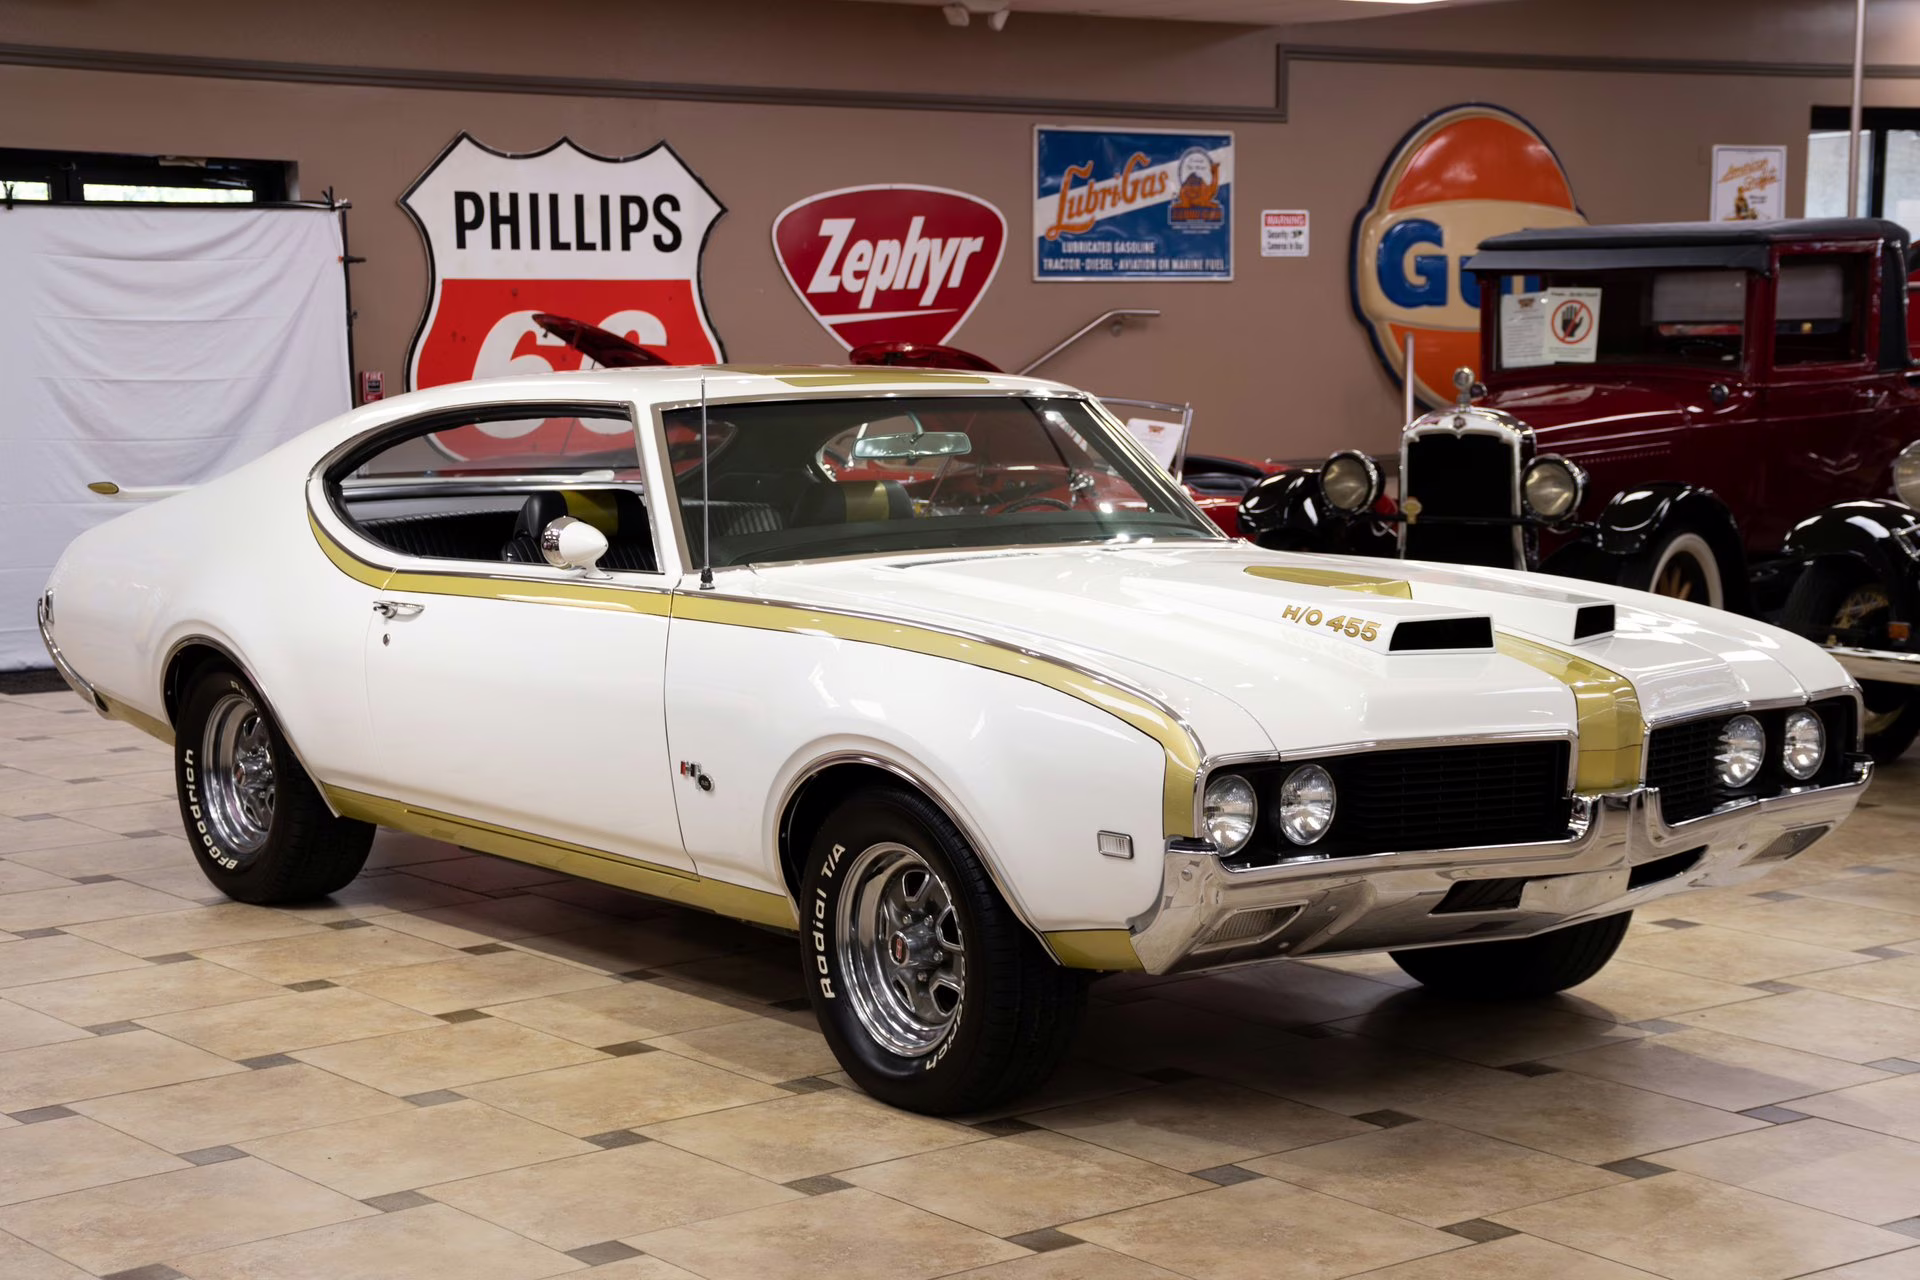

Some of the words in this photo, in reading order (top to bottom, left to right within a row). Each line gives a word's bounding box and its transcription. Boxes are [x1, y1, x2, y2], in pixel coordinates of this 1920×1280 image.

[454, 191, 683, 253] PHILLIPS
[1266, 215, 1305, 225] WARNING
[807, 216, 984, 309] Zephyr
[1043, 258, 1081, 271] TRACTOR
[1085, 258, 1113, 271] DIESEL
[1118, 258, 1157, 271] AVIATION
[1158, 258, 1170, 271] OR
[1171, 258, 1204, 271] MARINE
[1205, 258, 1226, 271] FUEL
[1062, 241, 1112, 254] LUBRICATED
[1114, 242, 1156, 254] GASOLINE
[1282, 604, 1322, 626] H/O
[1326, 615, 1382, 642] 455
[184, 748, 239, 870] BFGoodrich
[821, 843, 846, 880] T/A
[811, 887, 836, 1000] Radial
